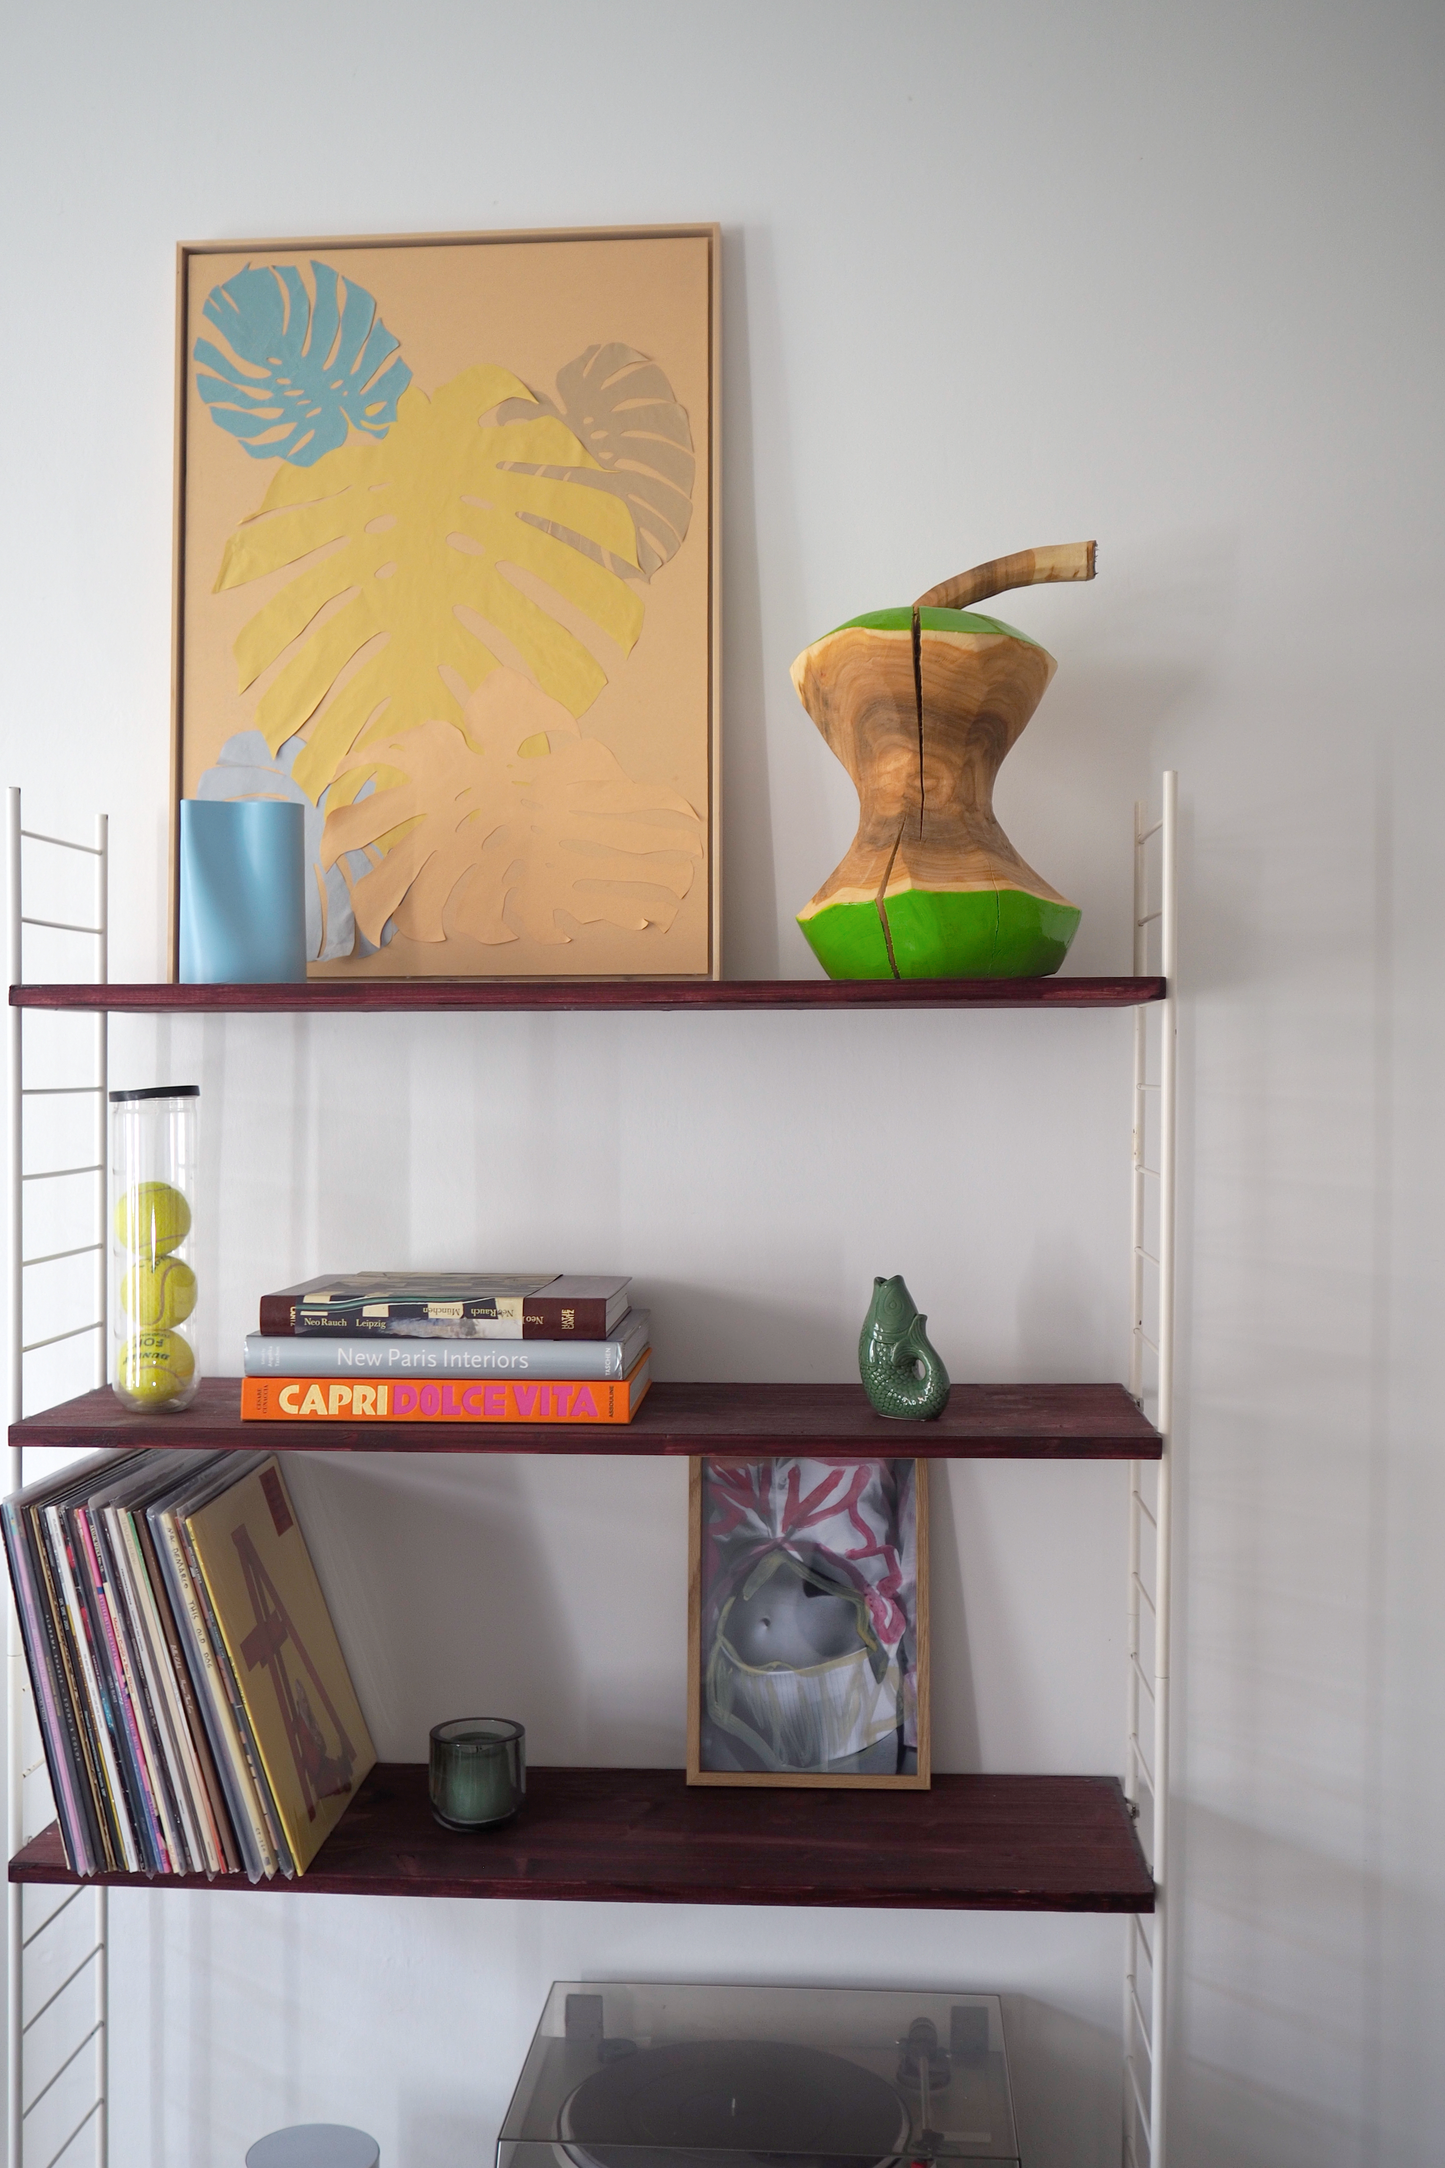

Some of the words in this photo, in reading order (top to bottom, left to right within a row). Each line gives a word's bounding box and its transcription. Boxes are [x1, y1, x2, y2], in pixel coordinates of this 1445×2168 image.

[422, 1307, 461, 1316] München
[470, 1307, 496, 1317] Rauch
[567, 1309, 575, 1330] CANTZ
[304, 1317, 321, 1326] Neo
[321, 1317, 347, 1327] Rauch
[355, 1318, 387, 1329] Leipzig
[526, 1315, 544, 1325] Neo
[336, 1347, 381, 1367] New
[388, 1348, 437, 1368] Paris
[443, 1349, 529, 1369] Interiors
[278, 1384, 388, 1416] CAPRI
[393, 1384, 505, 1417] DOLCE
[511, 1385, 599, 1418] VITA
[167, 1527, 176, 1543] MAC
[172, 1547, 190, 1589] DEMARCO
[188, 1600, 199, 1620] THIS
[196, 1628, 206, 1644] OLD
[203, 1652, 213, 1669] DOG
[46, 1614, 56, 1650] ALABAMA
[54, 1654, 63, 1683] SHAKES
[72, 1737, 80, 1762] COLOR
